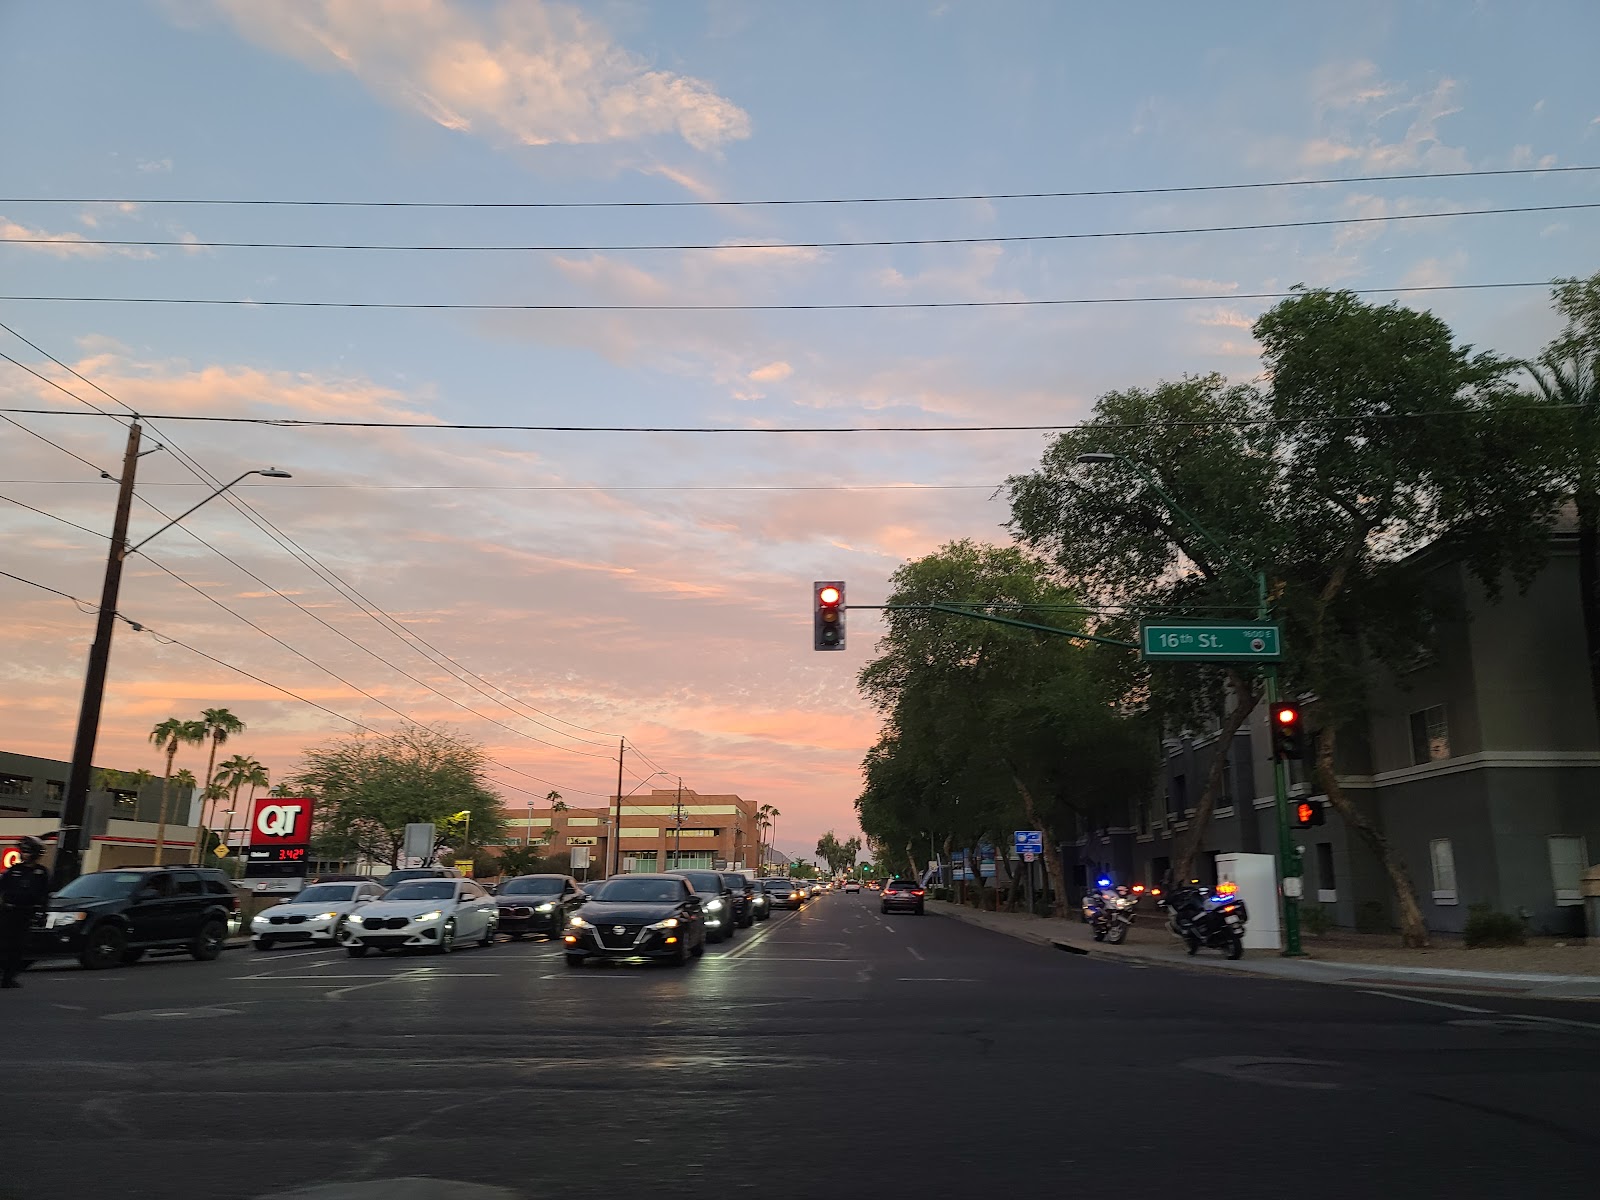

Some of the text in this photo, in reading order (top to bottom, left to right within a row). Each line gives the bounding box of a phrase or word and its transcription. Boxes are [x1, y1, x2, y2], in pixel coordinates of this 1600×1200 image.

[1159, 633, 1224, 648] 16th St.
[257, 805, 302, 837] QT
